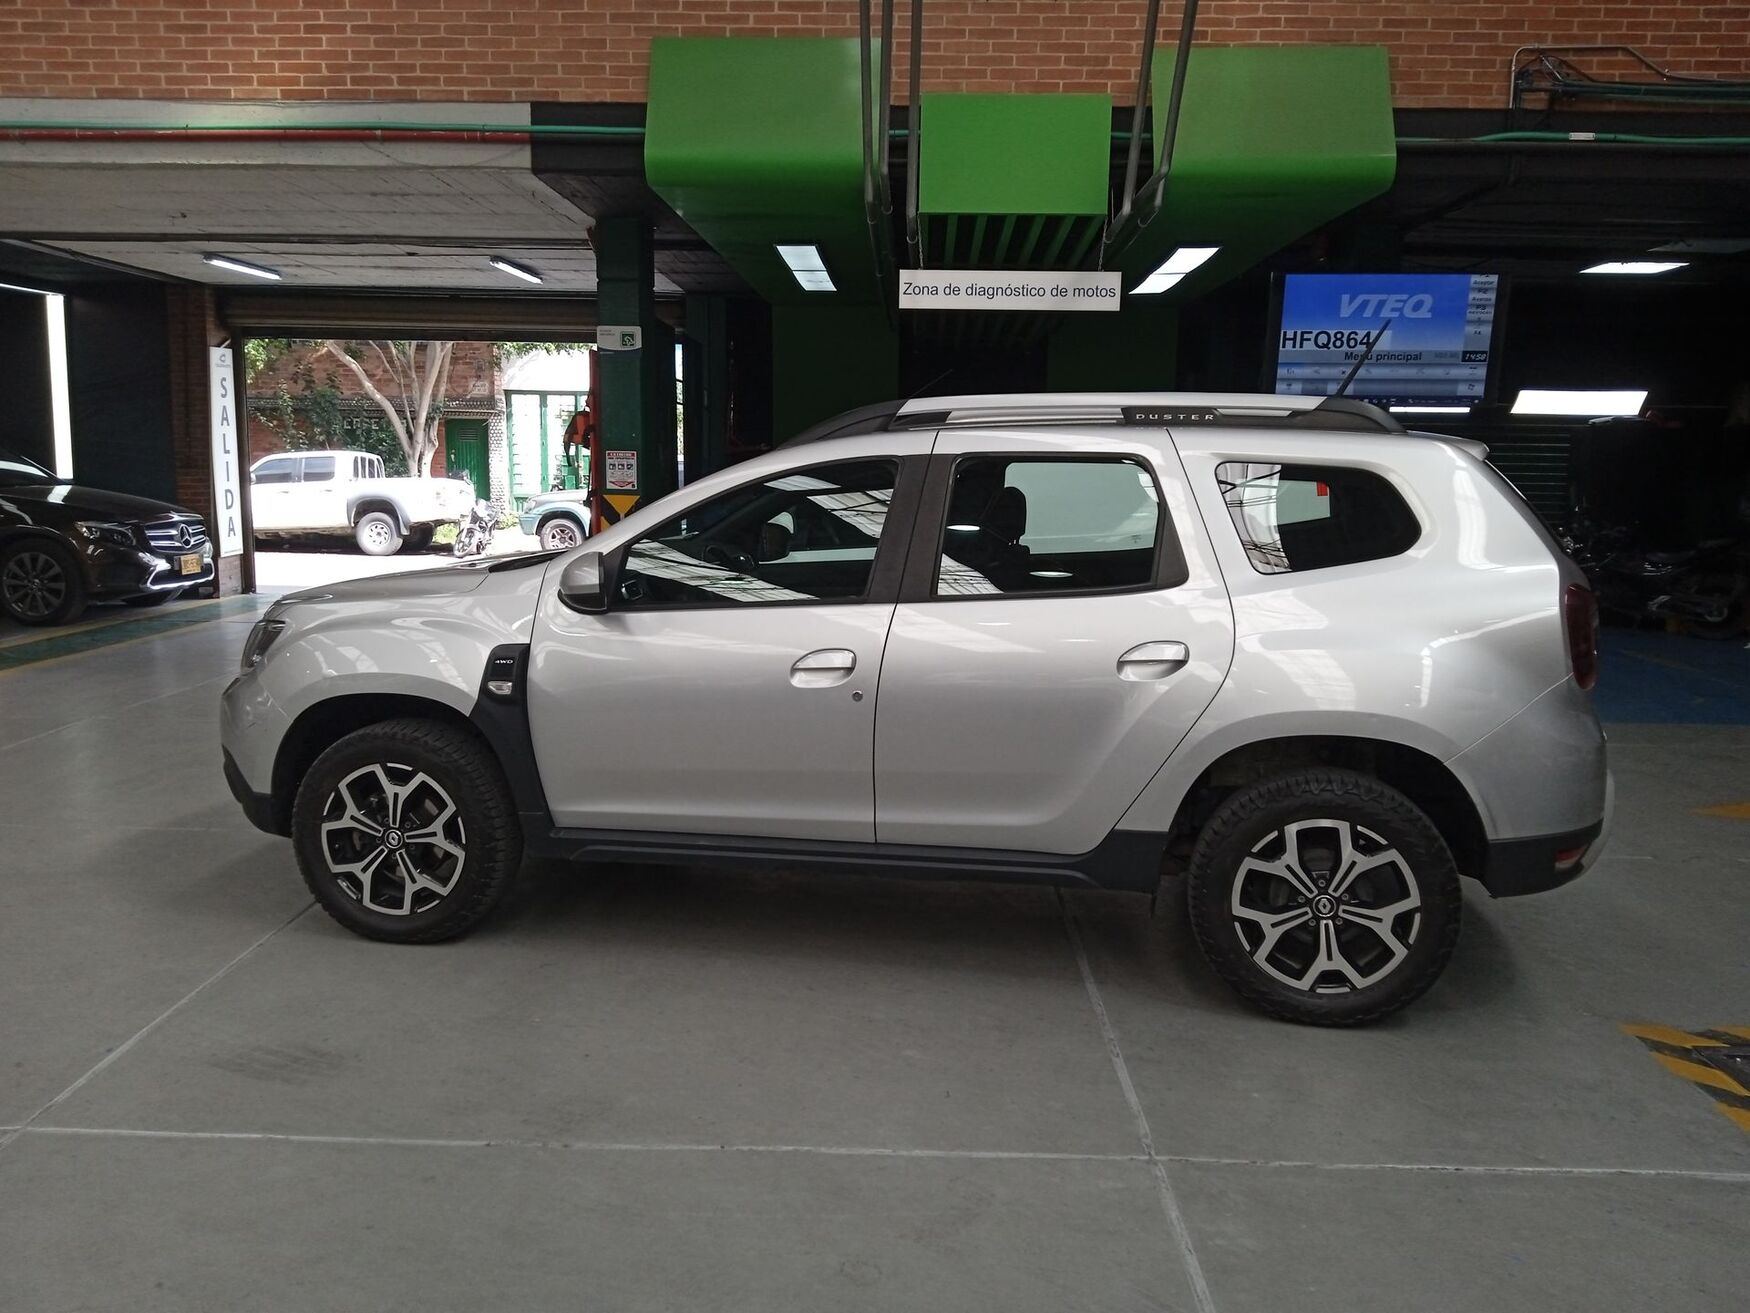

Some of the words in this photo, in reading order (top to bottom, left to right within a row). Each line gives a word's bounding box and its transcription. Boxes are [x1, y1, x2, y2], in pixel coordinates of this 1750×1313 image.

[902, 282, 939, 296] Zona
[943, 283, 961, 296] de
[965, 283, 1046, 300] diagnóstico
[1050, 284, 1068, 298] de
[1072, 286, 1117, 298] motos
[1339, 294, 1433, 318] VTEQ
[1281, 330, 1373, 350] HFQ864
[1376, 351, 1422, 363] principal
[1135, 413, 1215, 421] DUSTER
[220, 376, 237, 538] SALIDA
